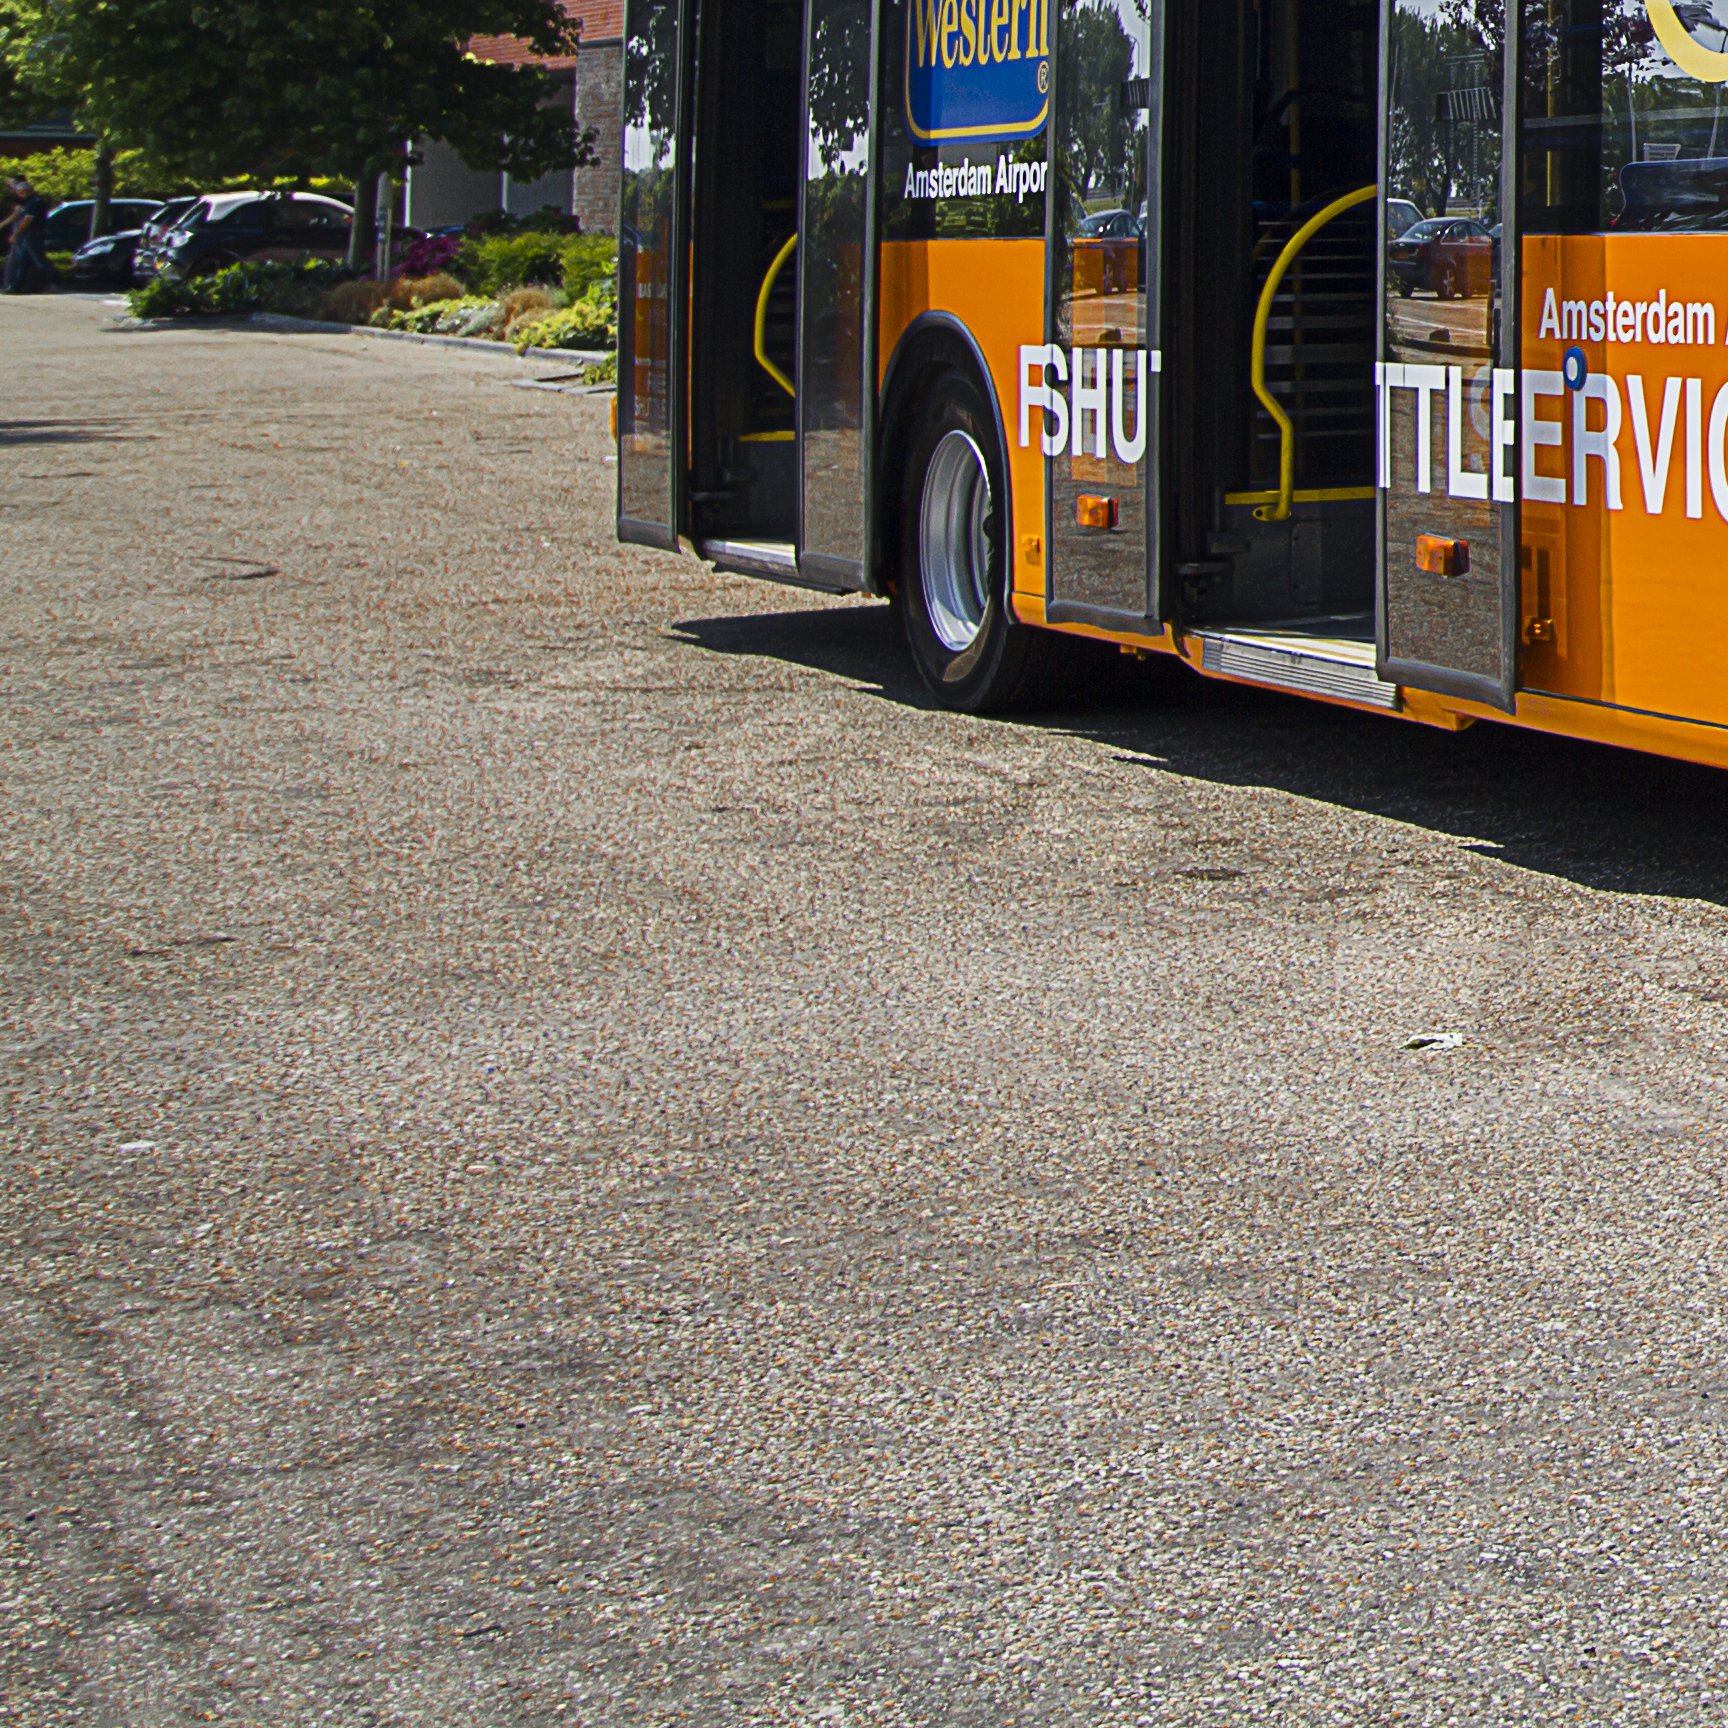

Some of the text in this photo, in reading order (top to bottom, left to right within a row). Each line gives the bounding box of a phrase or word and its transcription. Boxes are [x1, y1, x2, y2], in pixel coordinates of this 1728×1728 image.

[904, 153, 1049, 204] Amsterdam Airpor
[1537, 286, 1717, 346] Amsterdam
